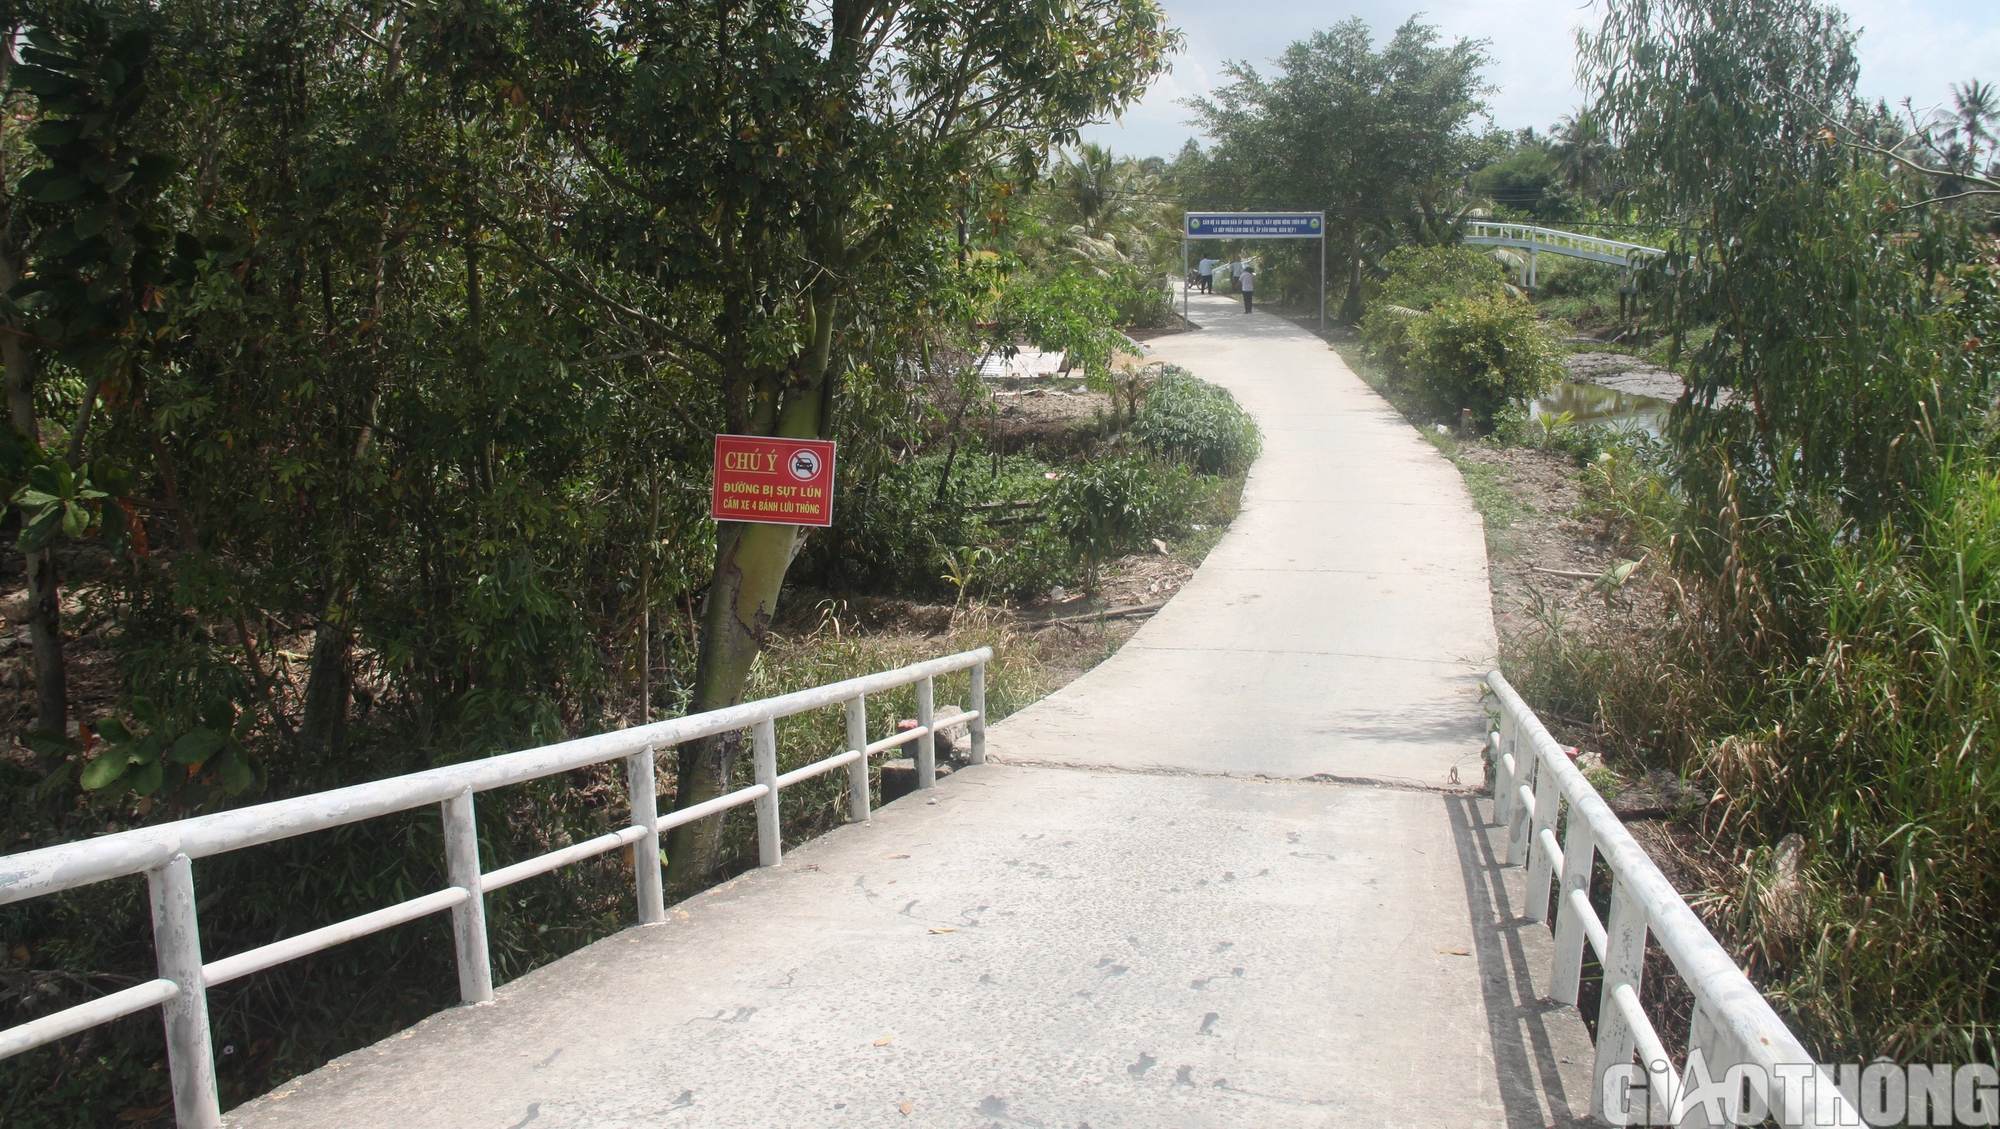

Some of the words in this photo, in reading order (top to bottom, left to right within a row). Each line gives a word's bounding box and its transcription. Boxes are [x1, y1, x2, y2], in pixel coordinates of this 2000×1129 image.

[725, 448, 762, 470] CHÚ
[766, 449, 778, 471] Ý
[724, 481, 760, 494] ĐƯỜNG
[762, 485, 774, 497] BỊ
[777, 486, 797, 498] SỤT
[800, 485, 822, 498] LÚN
[723, 496, 739, 509] CẤM
[740, 500, 750, 510] XE
[752, 501, 756, 510] 4
[758, 499, 778, 512] BÁNH
[780, 502, 794, 513] LƯU
[796, 502, 820, 514] THÔNG
